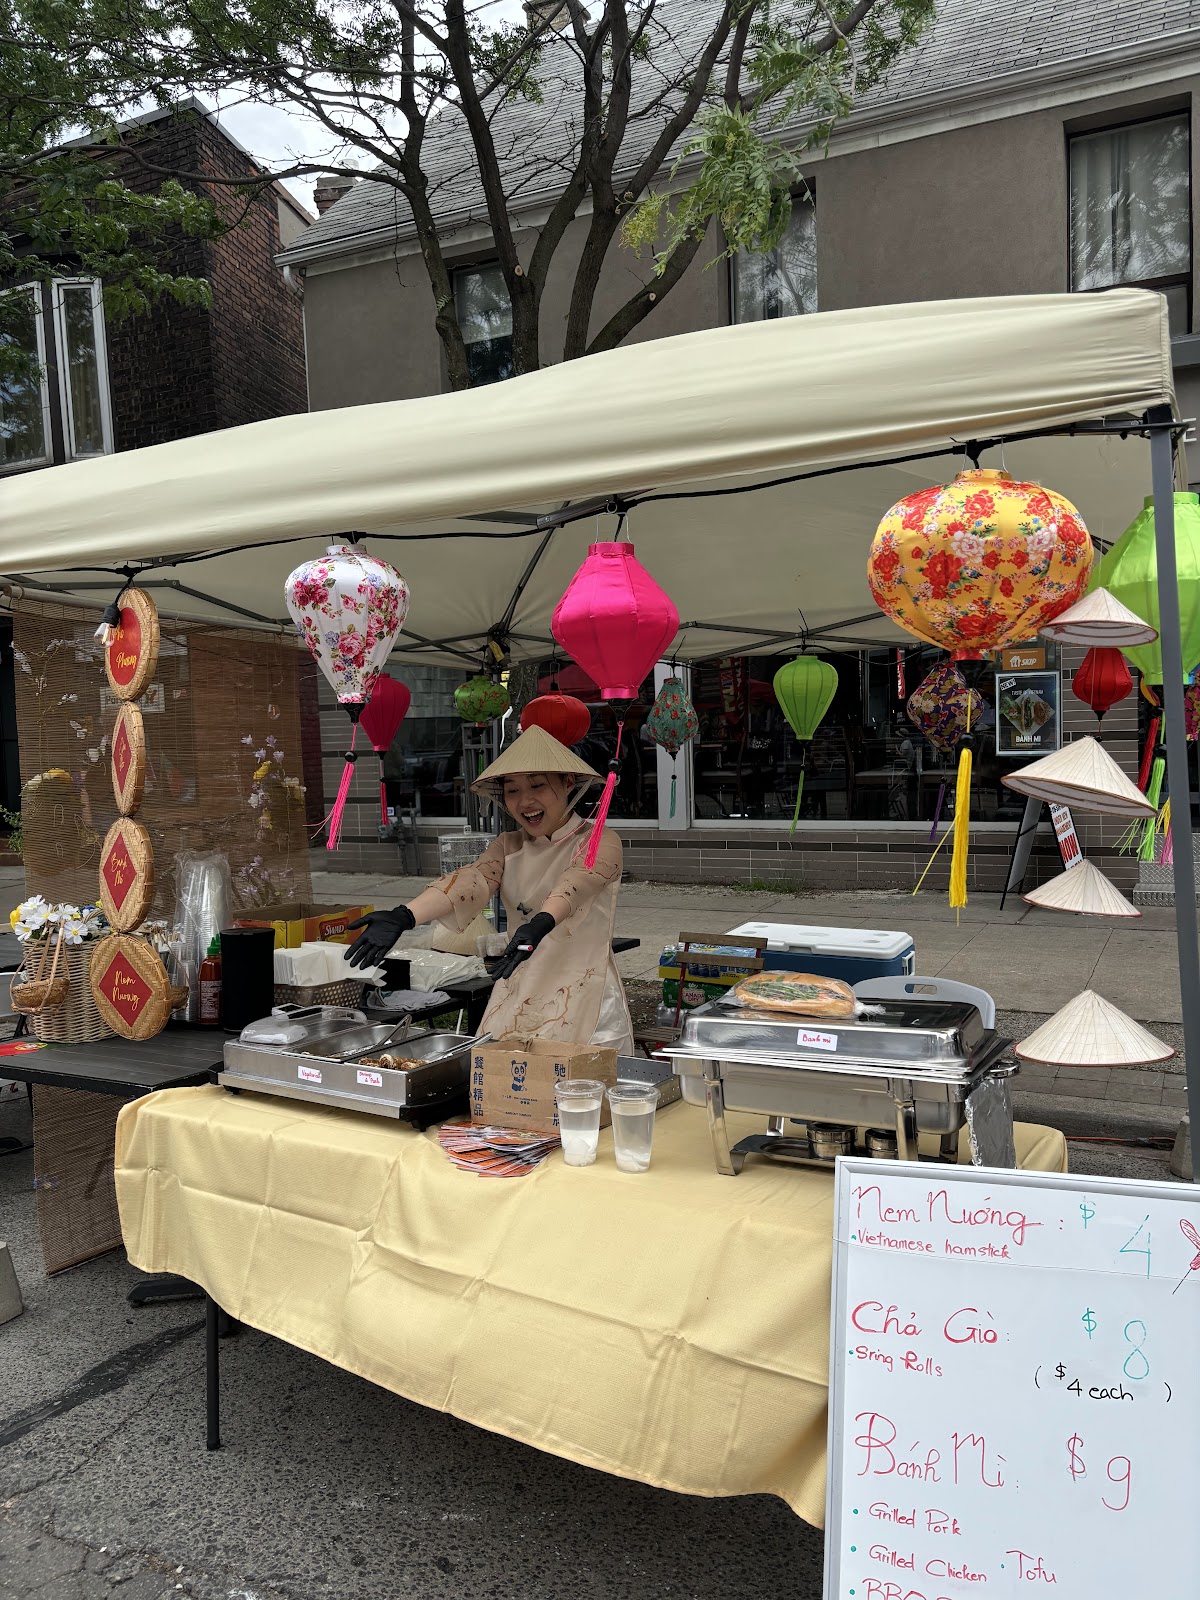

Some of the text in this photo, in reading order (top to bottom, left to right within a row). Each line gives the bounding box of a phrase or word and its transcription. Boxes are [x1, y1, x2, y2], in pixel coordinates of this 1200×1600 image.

[1020, 657, 1037, 666] SKIP
[1058, 832, 1079, 864] NOW
[324, 924, 345, 936] SWAD
[115, 970, 136, 986] Nem
[473, 1056, 484, 1117] 餐館精品
[852, 1186, 921, 1224] Nem
[1119, 1215, 1151, 1280] 4
[858, 1228, 1012, 1260] Vietnamese hamstick
[1082, 1308, 1097, 1340] $
[1123, 1320, 1150, 1380] 8
[855, 1345, 943, 1378] Sring Rolls
[1088, 1383, 1134, 1402] each
[1065, 1432, 1087, 1482] $
[868, 1502, 962, 1536] Grilled Pork
[868, 1544, 1058, 1584] Grilled Chicken Tofu
